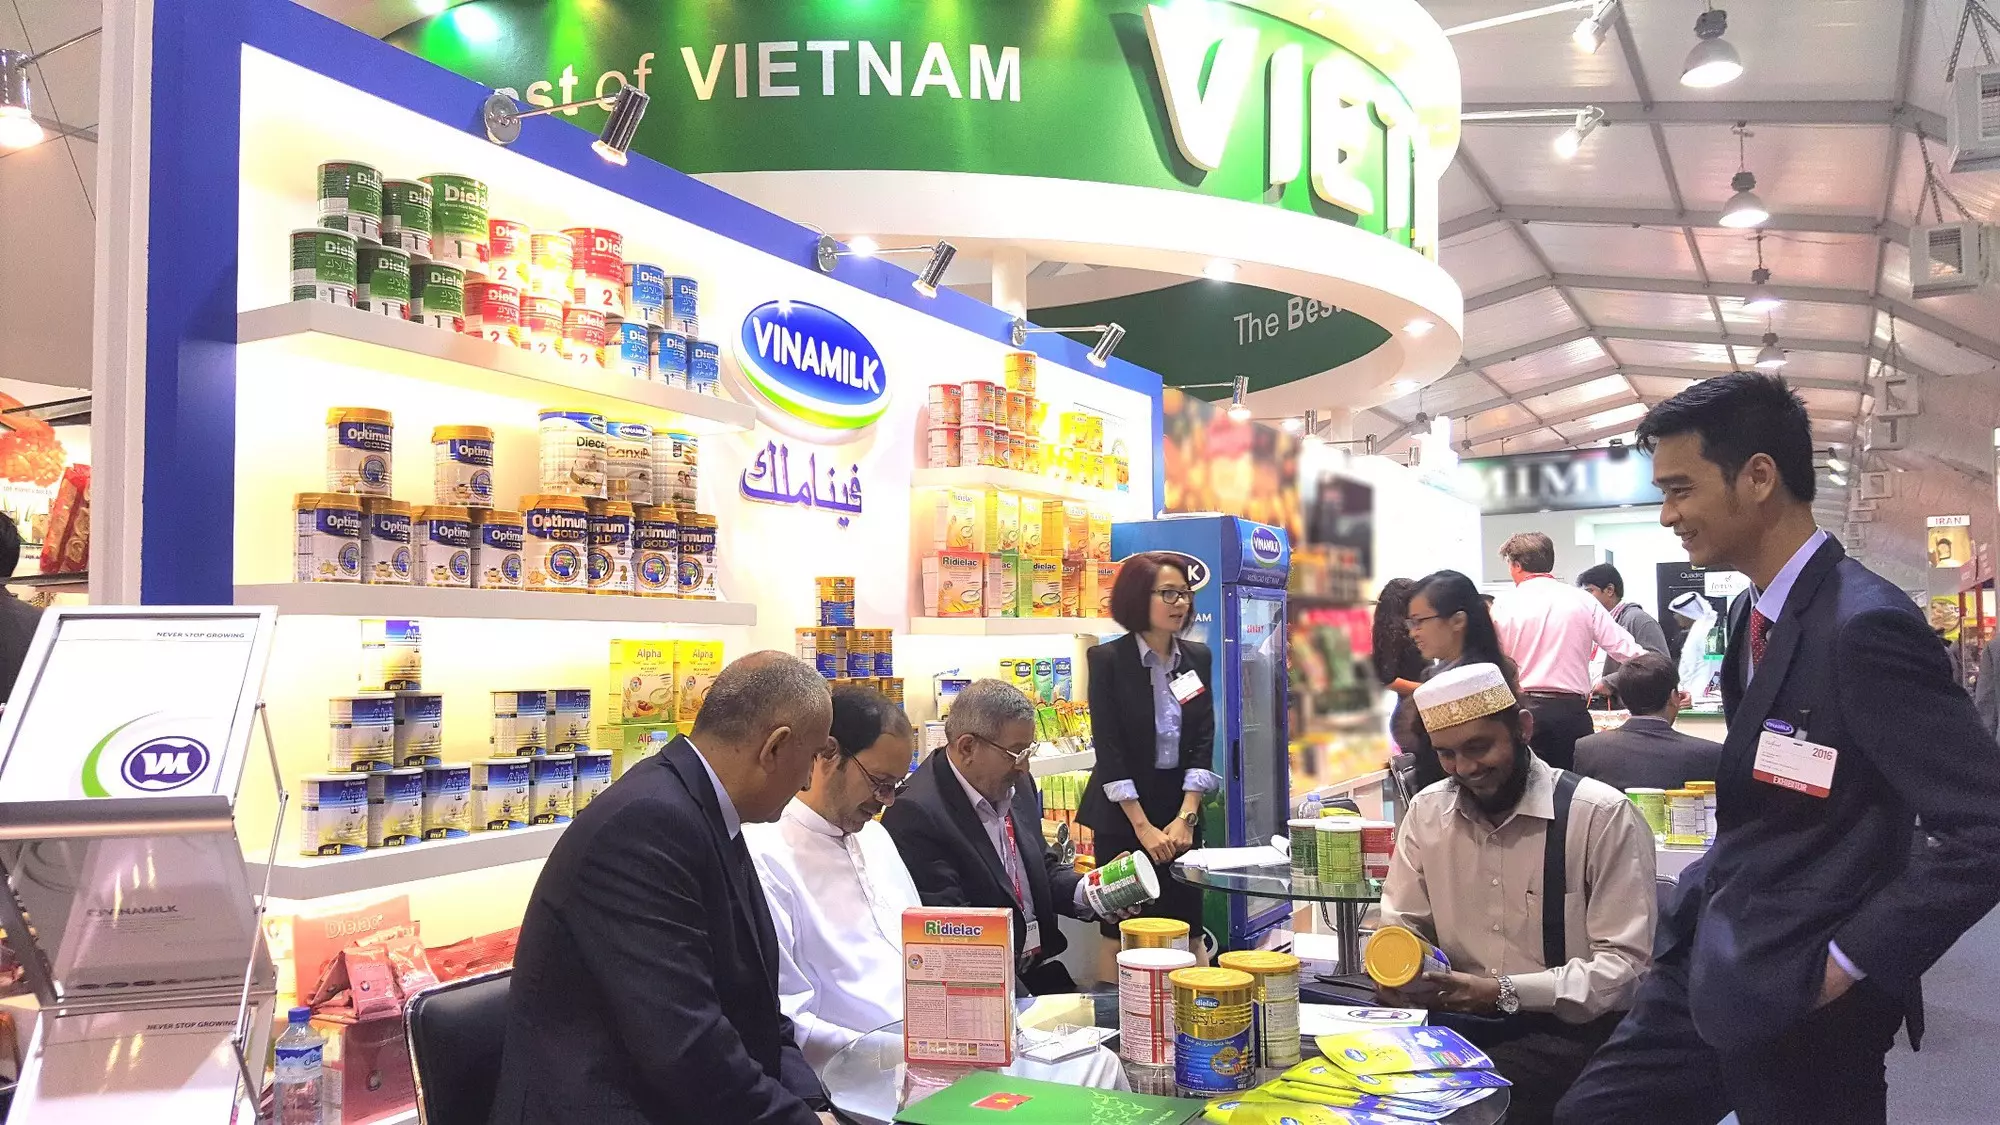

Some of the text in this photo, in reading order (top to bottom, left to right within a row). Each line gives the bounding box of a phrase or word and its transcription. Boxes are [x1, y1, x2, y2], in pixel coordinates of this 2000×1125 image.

[500, 40, 1022, 116] st of VIETNAM
[455, 240, 462, 258] 1
[498, 266, 507, 280] 2
[328, 287, 334, 303] 1
[603, 289, 613, 306] 2
[382, 302, 388, 315] 1
[435, 315, 441, 328] 1
[1233, 296, 1341, 346] The Bes
[752, 315, 880, 395] VINAMILK
[327, 515, 361, 529] Optim
[1936, 516, 1962, 525] IRAN
[492, 530, 523, 543] Optim
[552, 529, 579, 538] GOLD
[633, 526, 677, 541] ptimum
[644, 540, 668, 548] GOLD
[684, 544, 701, 553] OLD
[942, 556, 978, 567] Ridielac
[1033, 562, 1056, 571] dielac
[620, 565, 628, 581] 2
[1187, 564, 1201, 581] K
[706, 573, 713, 587] 4
[1195, 612, 1212, 622] AM
[637, 648, 661, 660] Alpha
[692, 648, 713, 660] Alpha
[637, 733, 652, 745] Alp
[1812, 747, 1833, 761] 2016
[1773, 776, 1807, 792] EXHIBITOR
[502, 820, 509, 829] 2
[548, 814, 554, 823] 2
[99, 904, 178, 917] VNAMILK
[925, 921, 981, 936] Ridielac
[1195, 1000, 1218, 1008] dielac
[176, 1021, 196, 1029] STOP
[197, 1019, 238, 1028] GROWING
